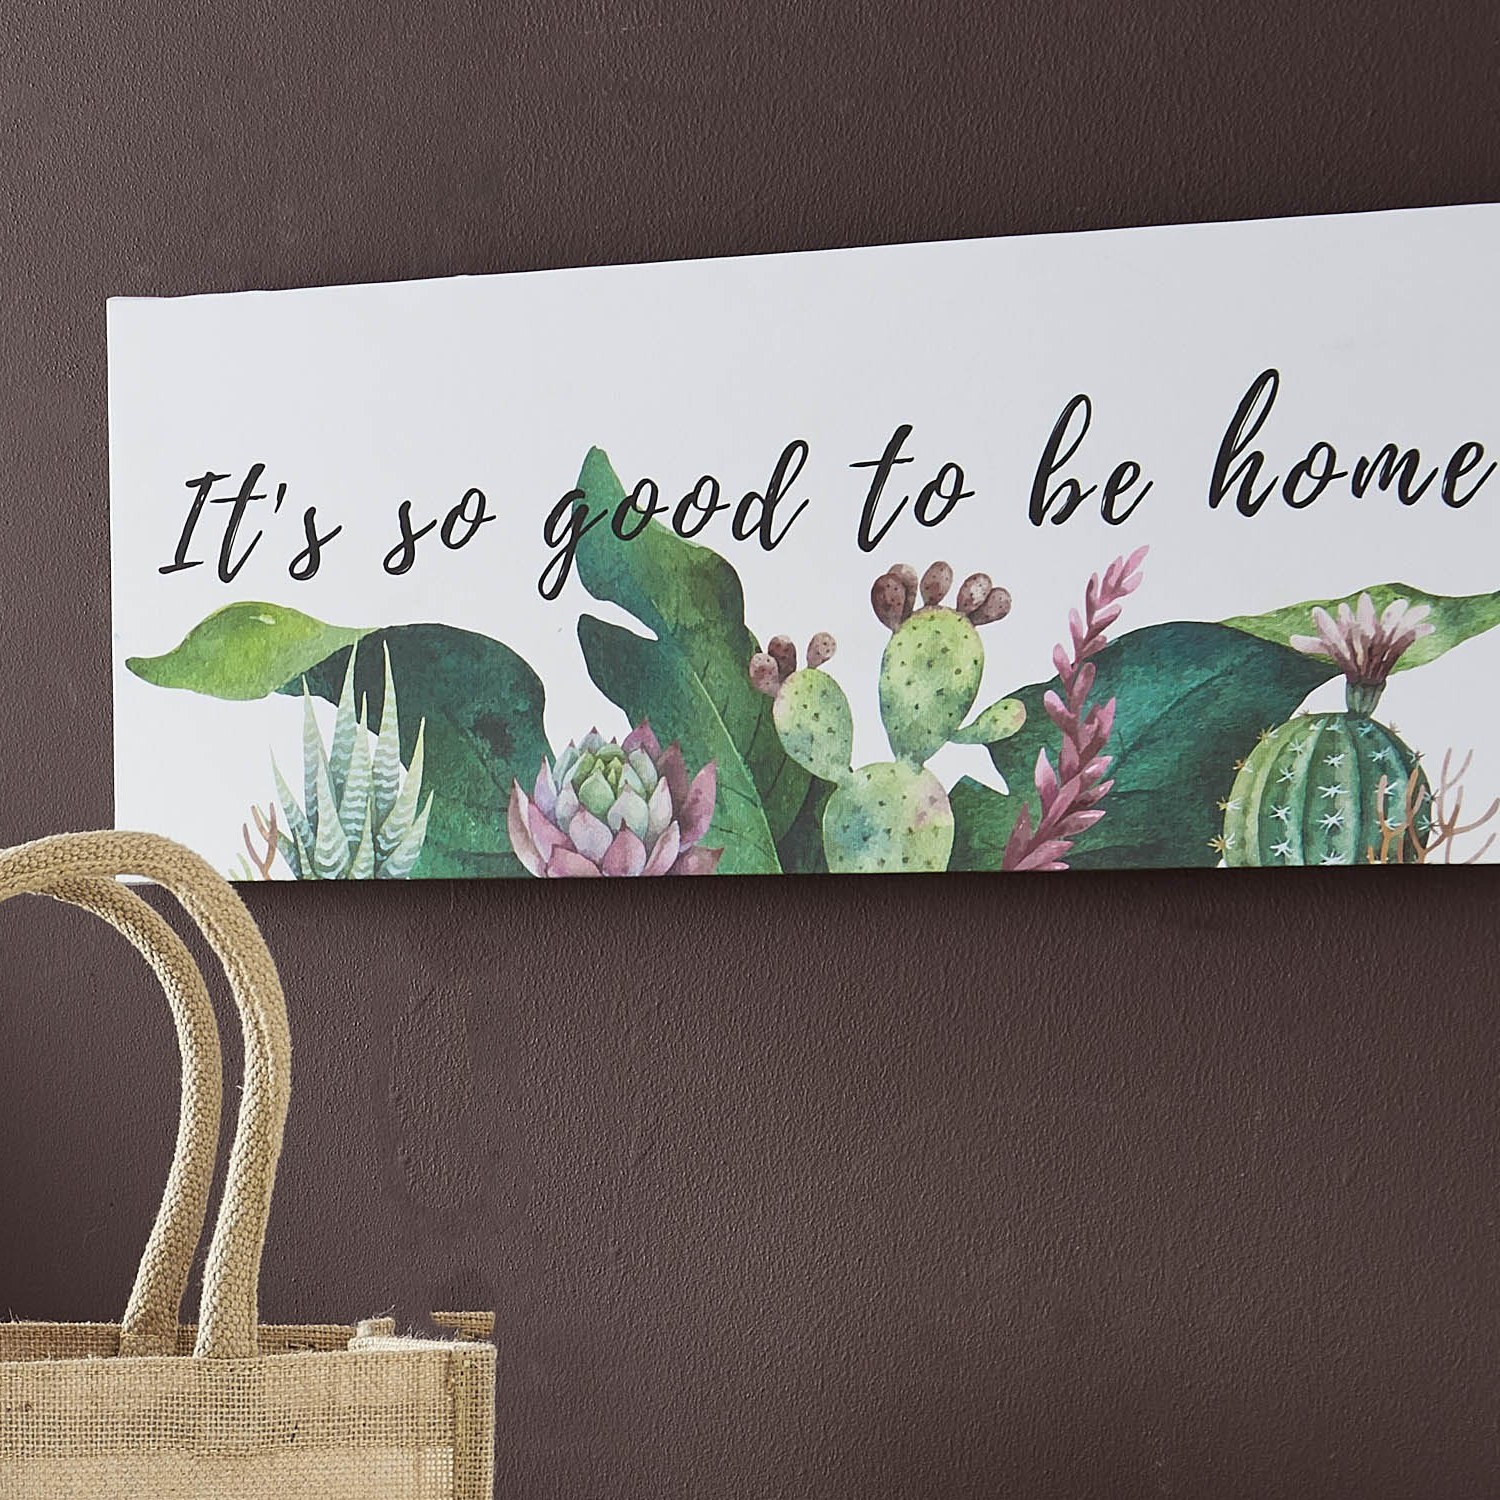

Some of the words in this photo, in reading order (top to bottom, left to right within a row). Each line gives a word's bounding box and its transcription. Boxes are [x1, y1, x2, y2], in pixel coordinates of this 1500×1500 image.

[159, 464, 342, 583] It's
[383, 488, 496, 575] so
[538, 440, 810, 600] good
[850, 425, 975, 552] to
[1029, 394, 1153, 526] be
[1209, 369, 1498, 517] home
